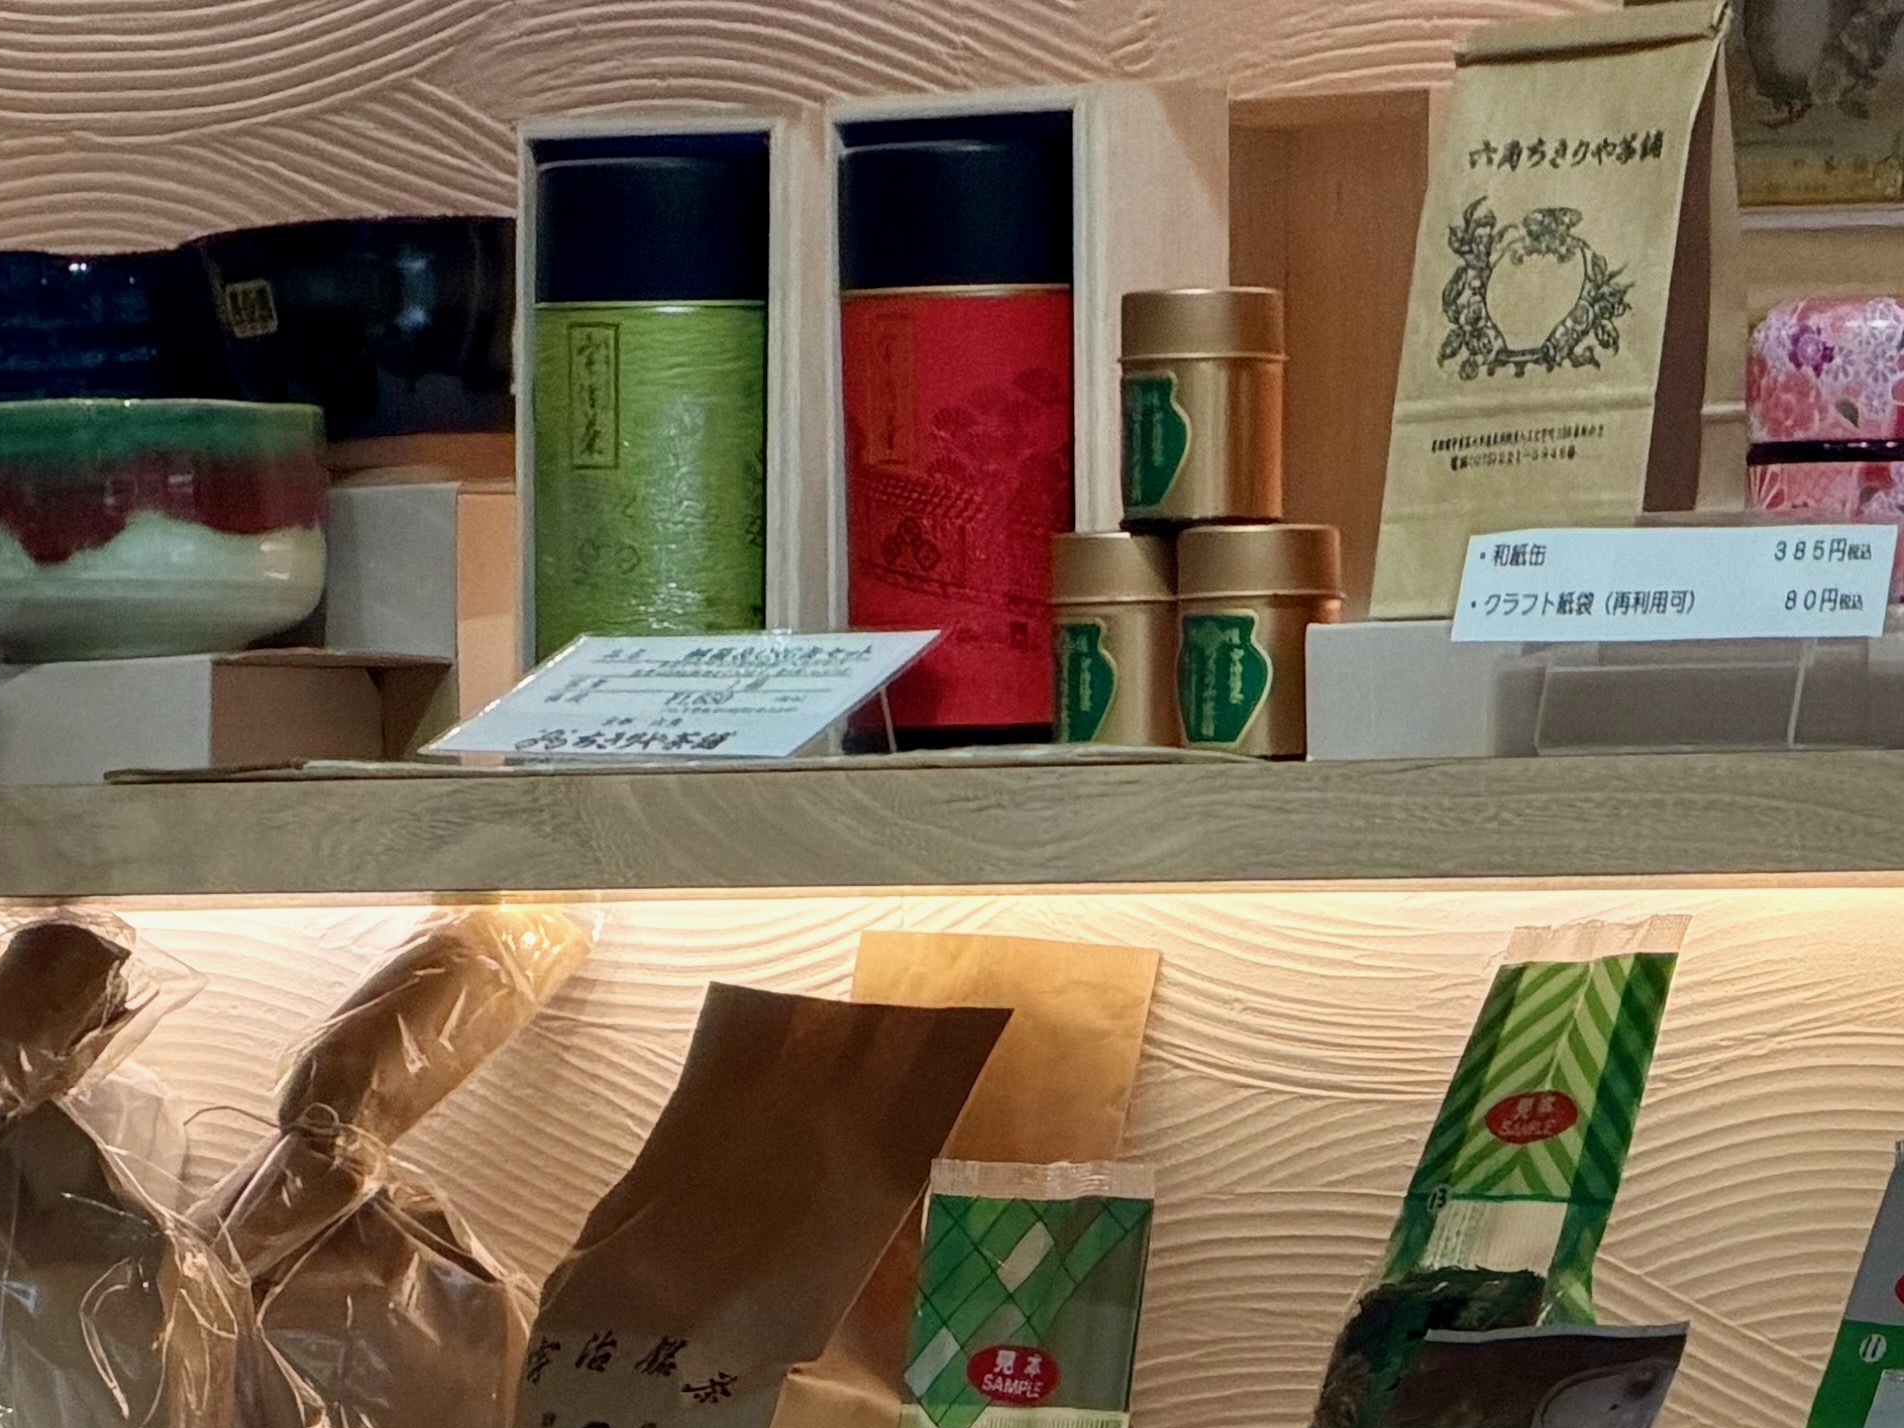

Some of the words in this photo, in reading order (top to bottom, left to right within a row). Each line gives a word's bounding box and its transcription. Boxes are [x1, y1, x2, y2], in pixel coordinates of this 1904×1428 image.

[1468, 128, 1666, 171] 六角ちきりや茶舗
[992, 1350, 1044, 1377] 見本
[981, 1372, 1043, 1399] SAMPLE
